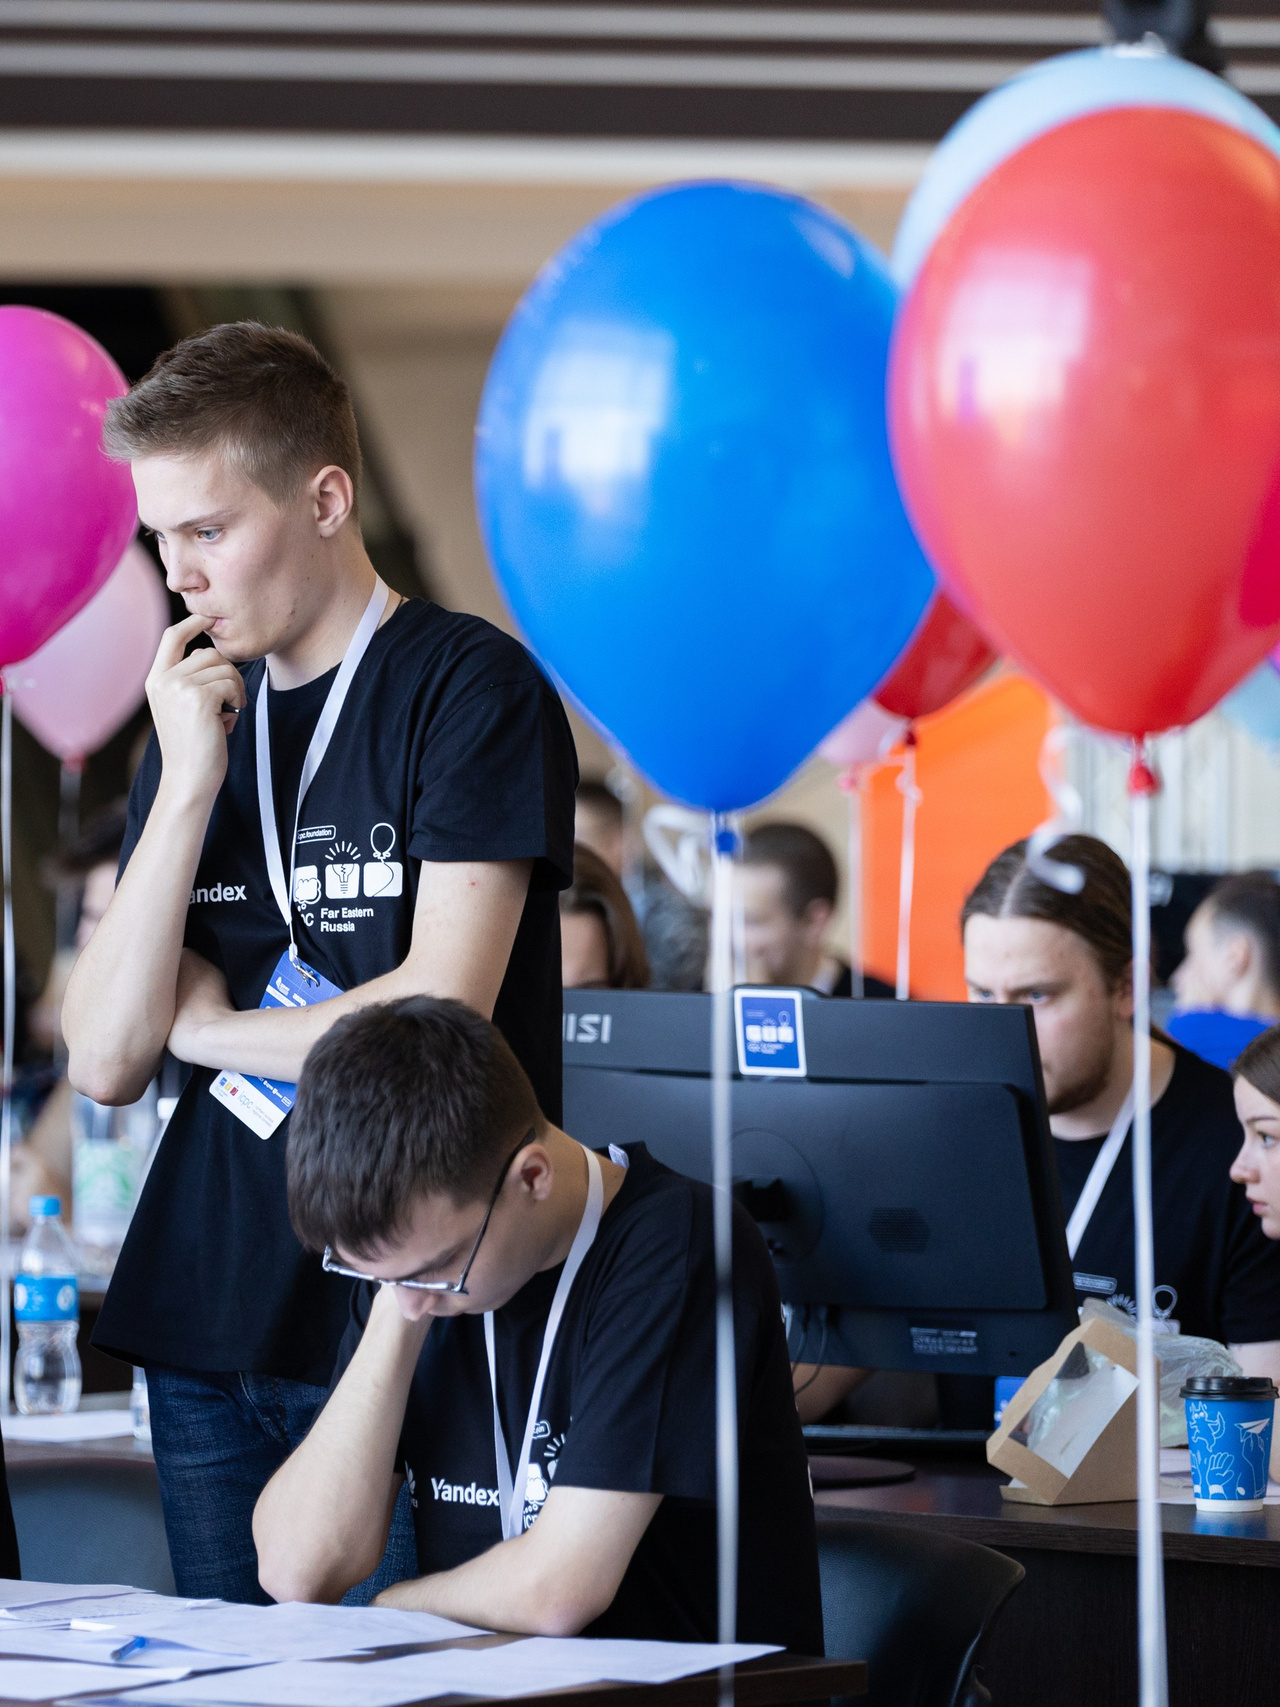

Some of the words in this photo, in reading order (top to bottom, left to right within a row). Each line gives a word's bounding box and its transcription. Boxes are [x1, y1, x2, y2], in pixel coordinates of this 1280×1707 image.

[321, 908, 339, 919] Far
[341, 907, 374, 918] Eastern
[321, 921, 355, 932] Russia
[431, 1477, 500, 1506] Yandex
